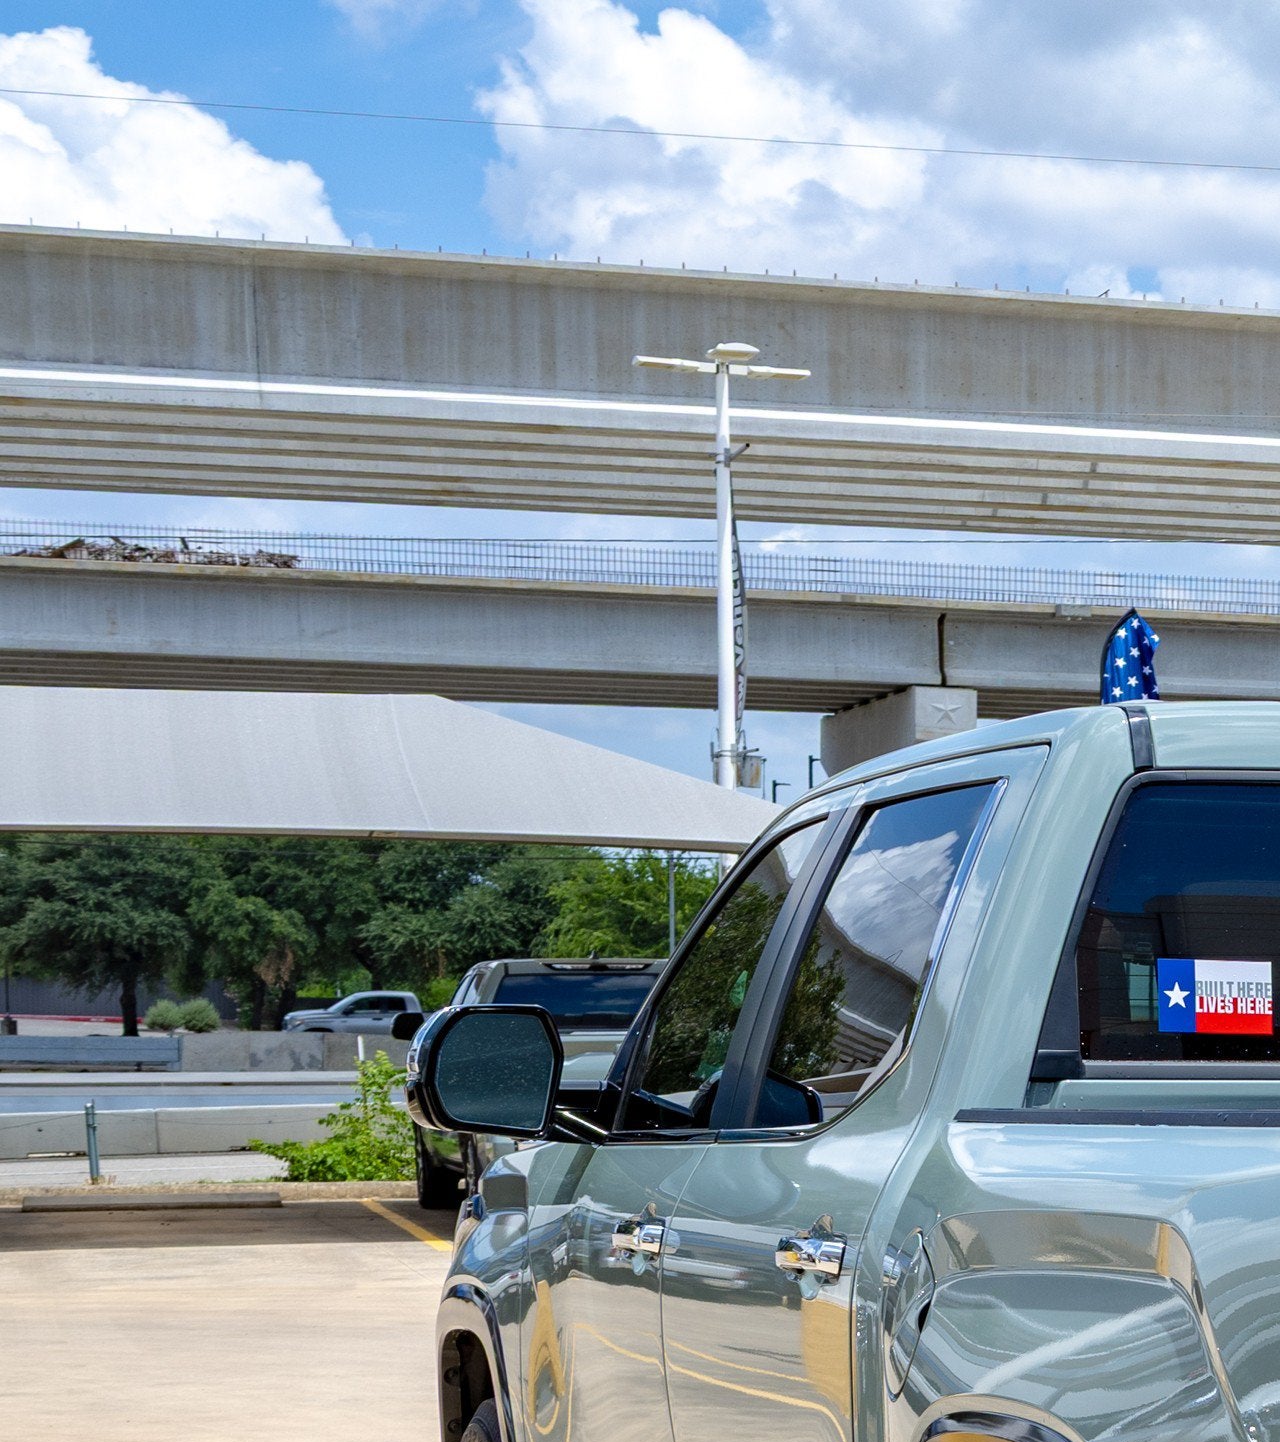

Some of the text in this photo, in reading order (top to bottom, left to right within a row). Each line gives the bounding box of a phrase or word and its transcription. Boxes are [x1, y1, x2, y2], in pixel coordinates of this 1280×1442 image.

[1195, 980, 1272, 998] BUILT HERE
[1196, 996, 1272, 1015] LIVES HERE
